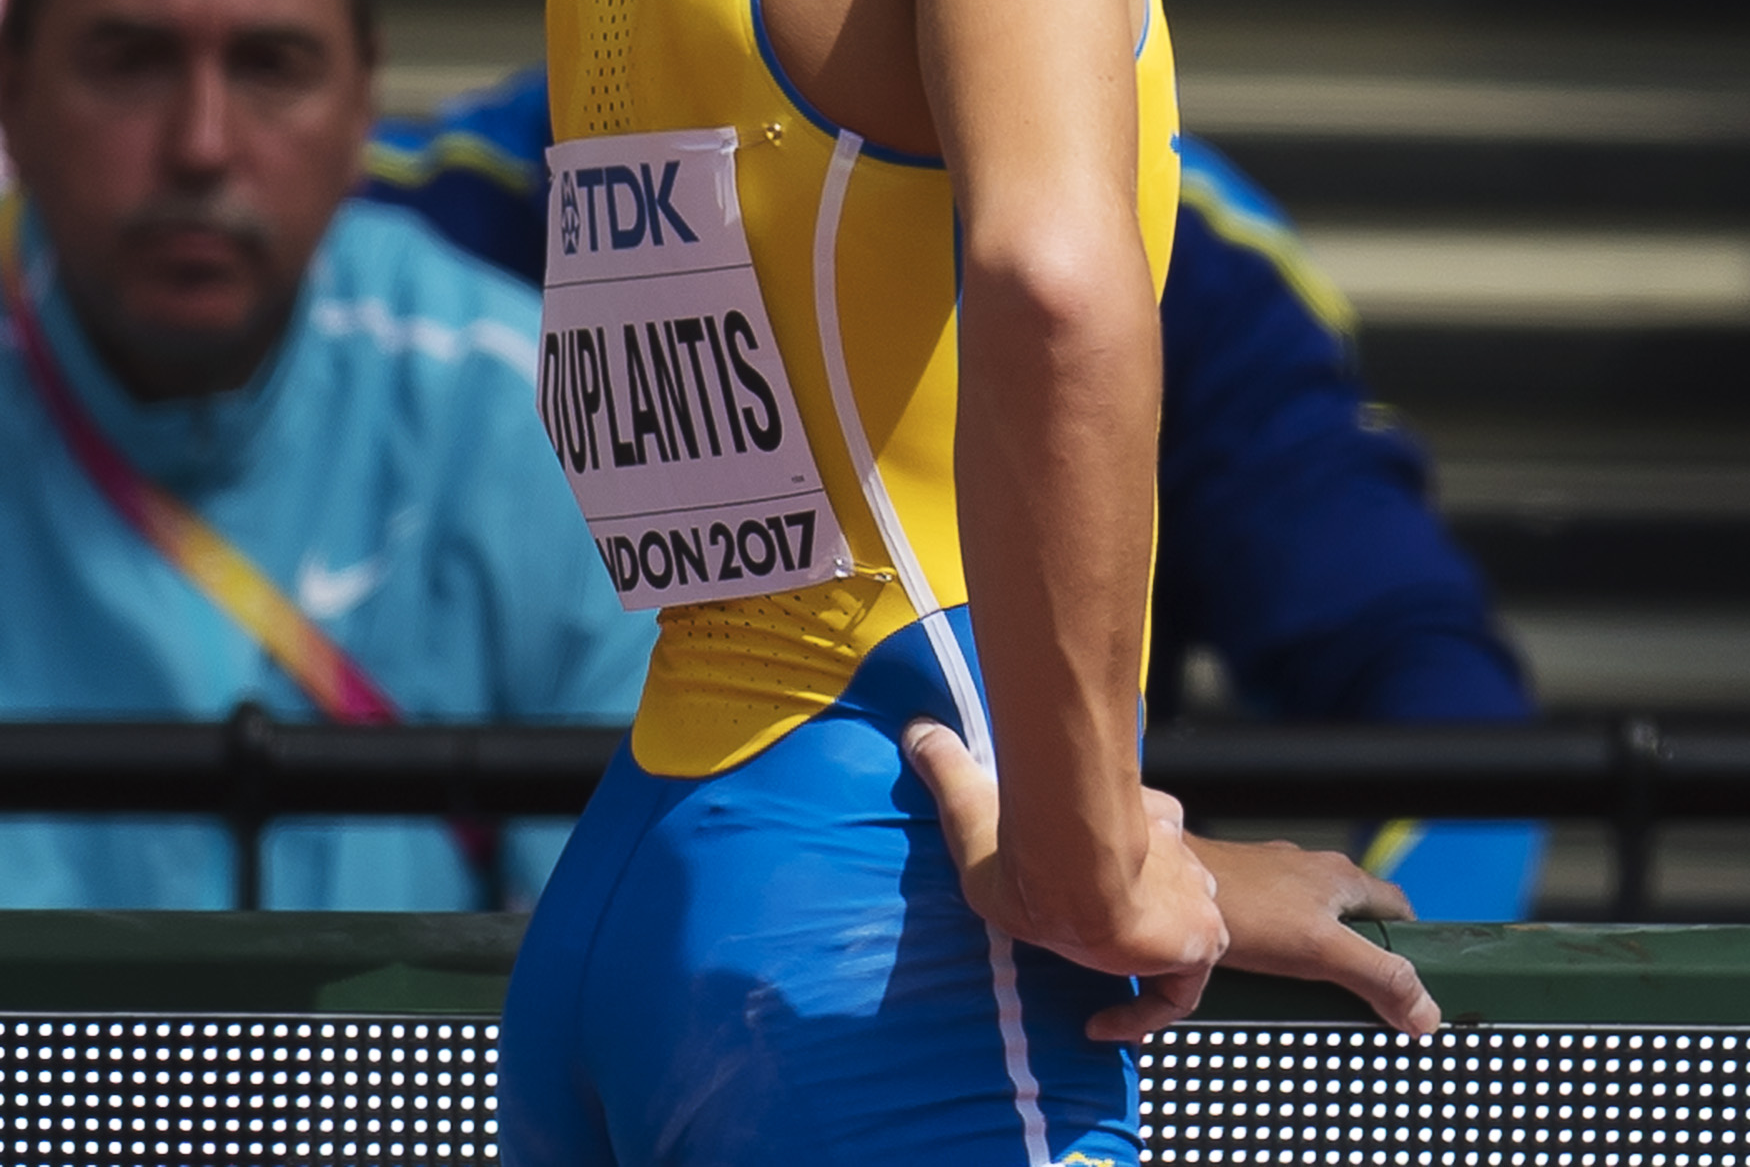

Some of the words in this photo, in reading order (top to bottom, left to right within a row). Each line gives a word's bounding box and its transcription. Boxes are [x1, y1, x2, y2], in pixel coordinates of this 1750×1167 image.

[575, 159, 700, 252] TDK
[541, 309, 783, 474] DUPLANTIS
[708, 509, 817, 583] 2017
